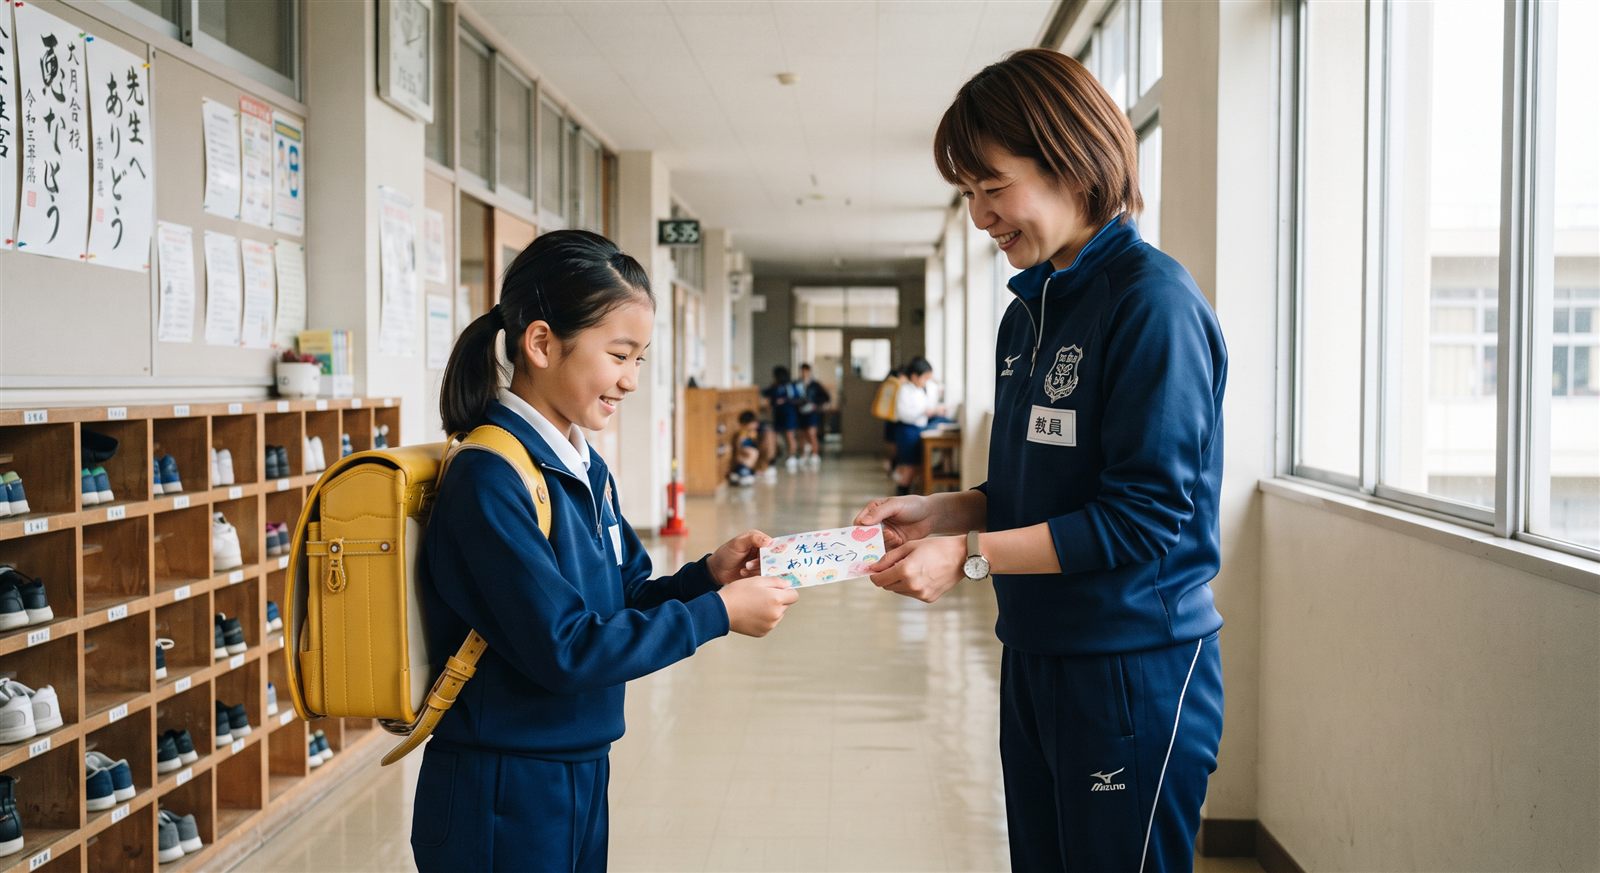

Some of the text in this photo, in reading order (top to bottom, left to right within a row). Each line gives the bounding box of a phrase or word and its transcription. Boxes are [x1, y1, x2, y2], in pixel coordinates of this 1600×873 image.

[126, 66, 146, 180] 先生へ
[1035, 416, 1063, 436] 教員
[795, 541, 847, 555] 先生へ
[787, 549, 858, 570] ありがとう
